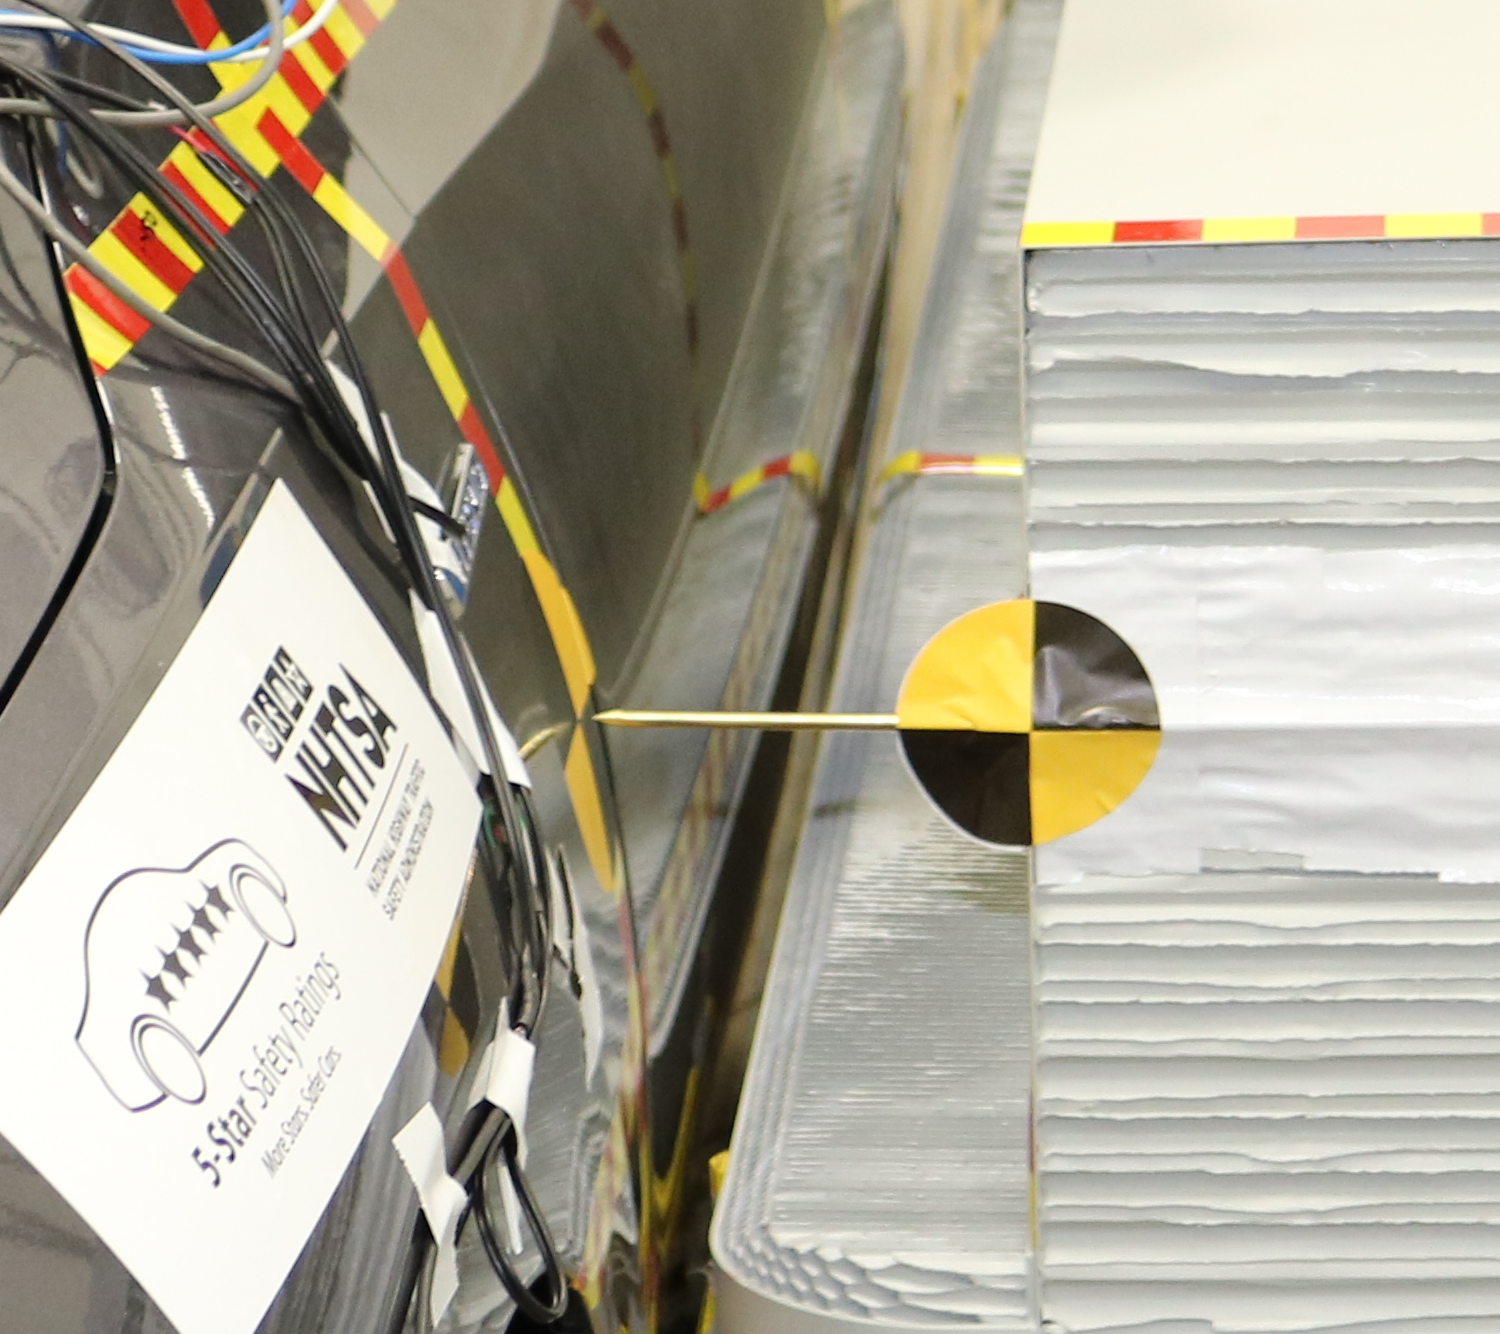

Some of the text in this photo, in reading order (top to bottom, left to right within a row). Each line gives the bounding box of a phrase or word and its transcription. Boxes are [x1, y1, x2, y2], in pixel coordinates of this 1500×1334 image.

[285, 662, 398, 853] NHTSA
[191, 952, 341, 1188] 5-Star Safety Ratings
[261, 1137, 290, 1177] More
